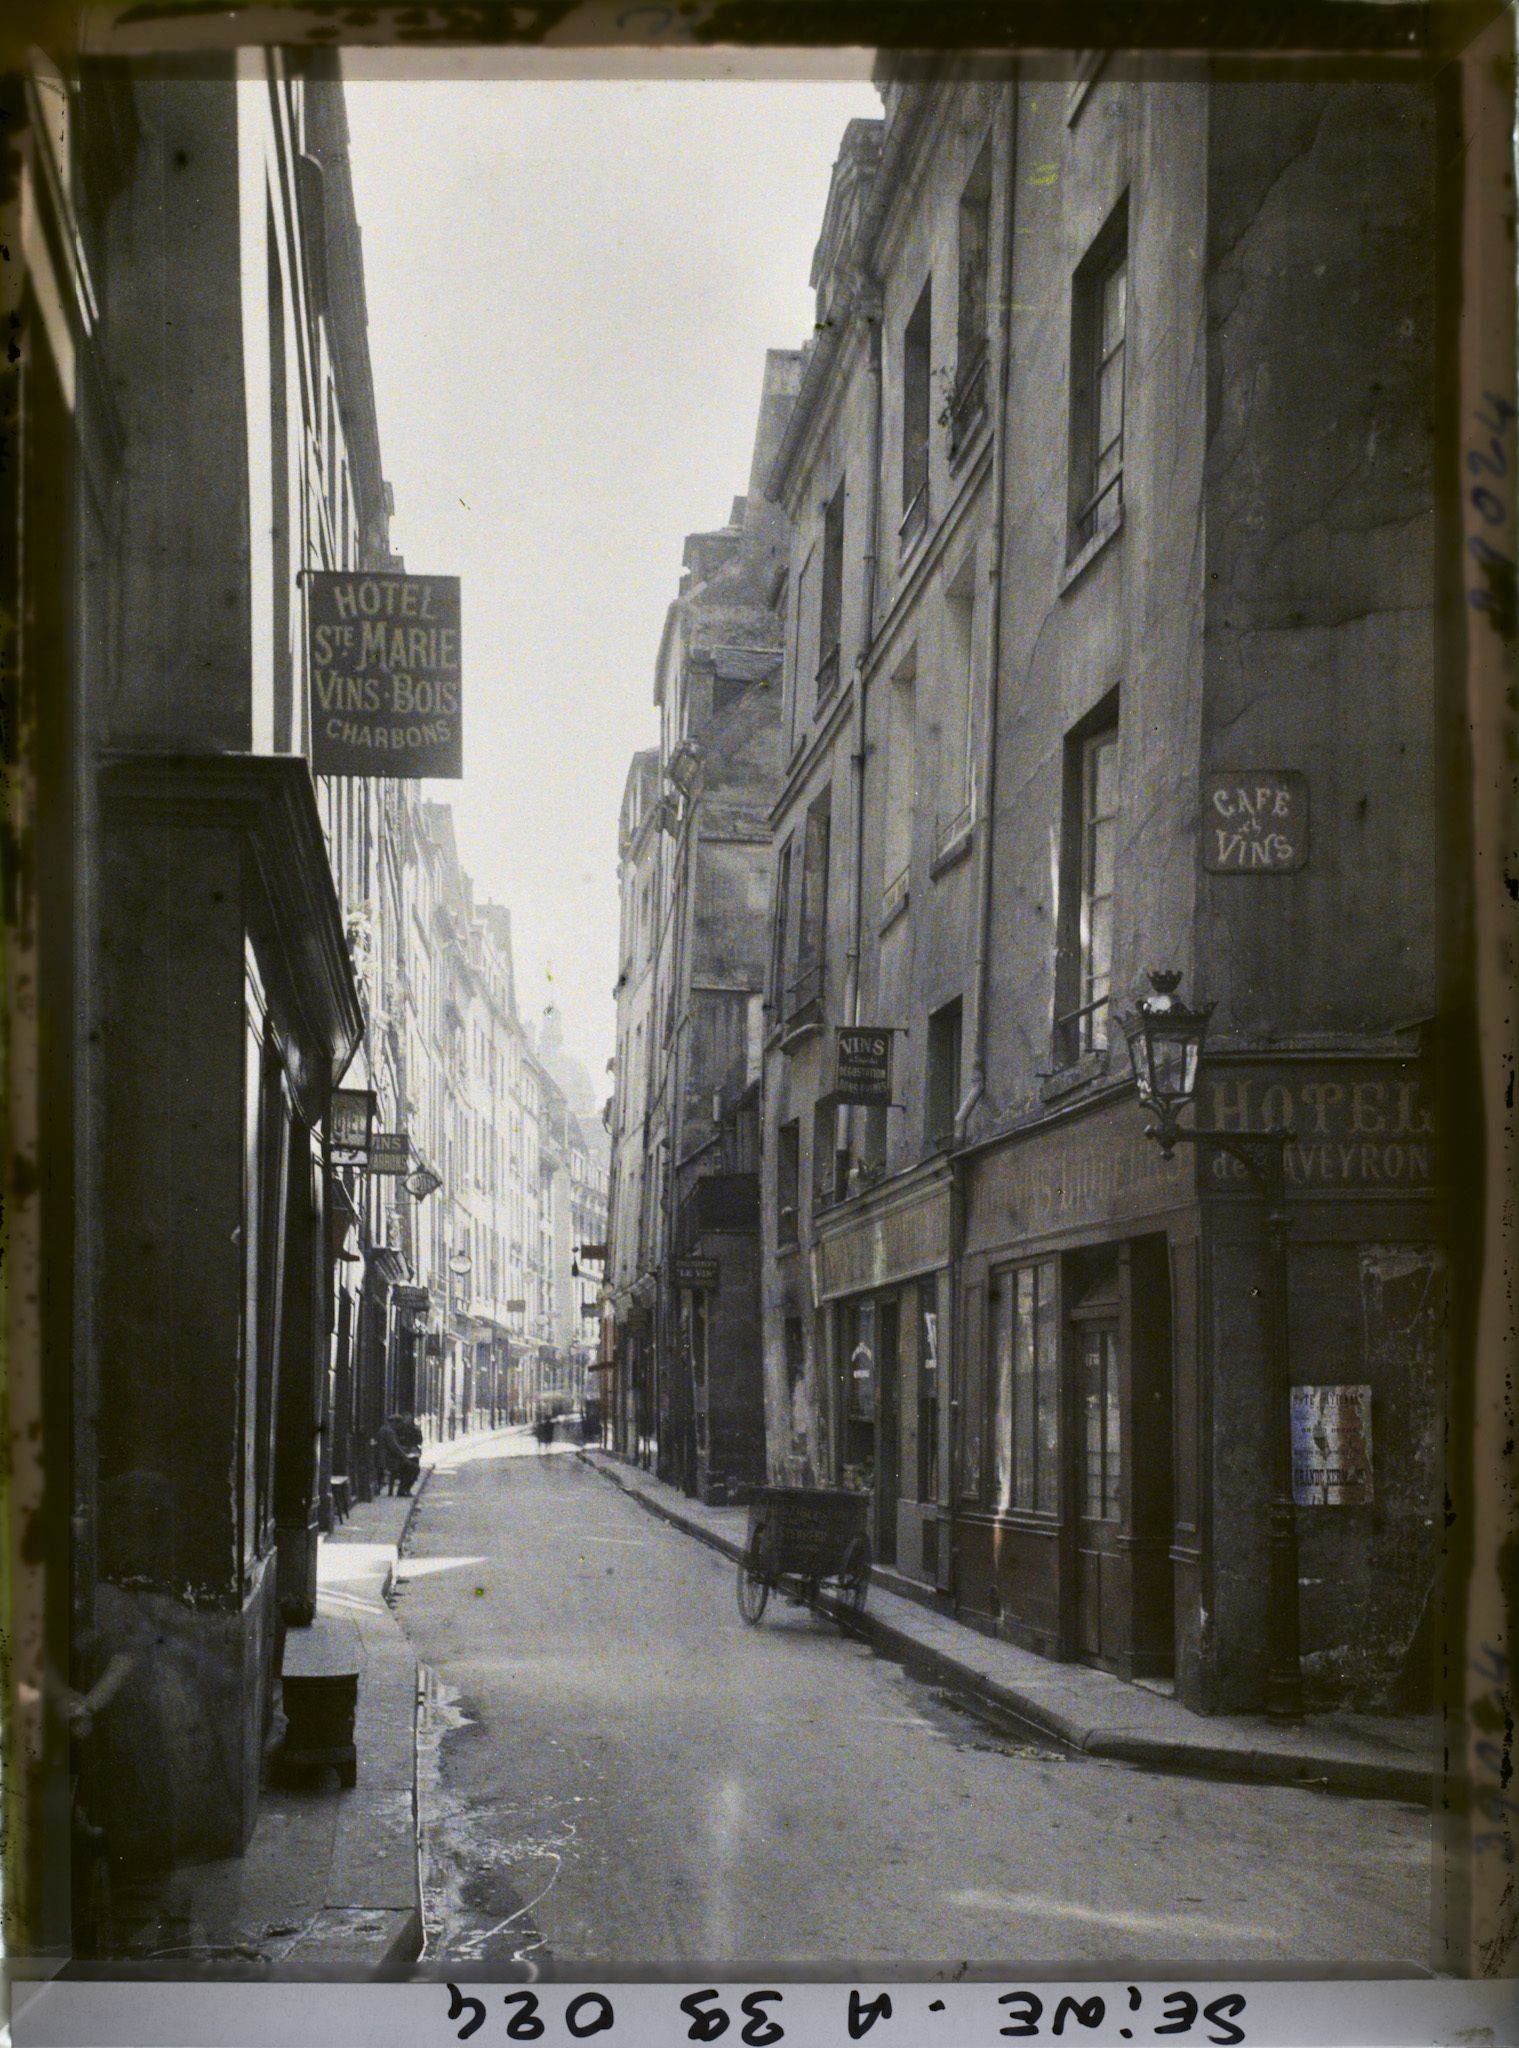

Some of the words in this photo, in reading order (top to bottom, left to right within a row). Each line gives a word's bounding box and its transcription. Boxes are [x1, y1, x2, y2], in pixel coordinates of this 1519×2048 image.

[355, 620, 458, 673] MARIE
[314, 669, 381, 712] VINS
[390, 673, 458, 715] BOIS
[326, 719, 452, 749] CHARBONS
[1215, 829, 1294, 867] VINS
[839, 1037, 885, 1056] VINS
[1209, 1079, 1436, 1134] HOTEL
[446, 1983, 614, 2041] 024
[847, 1990, 893, 2040] A
